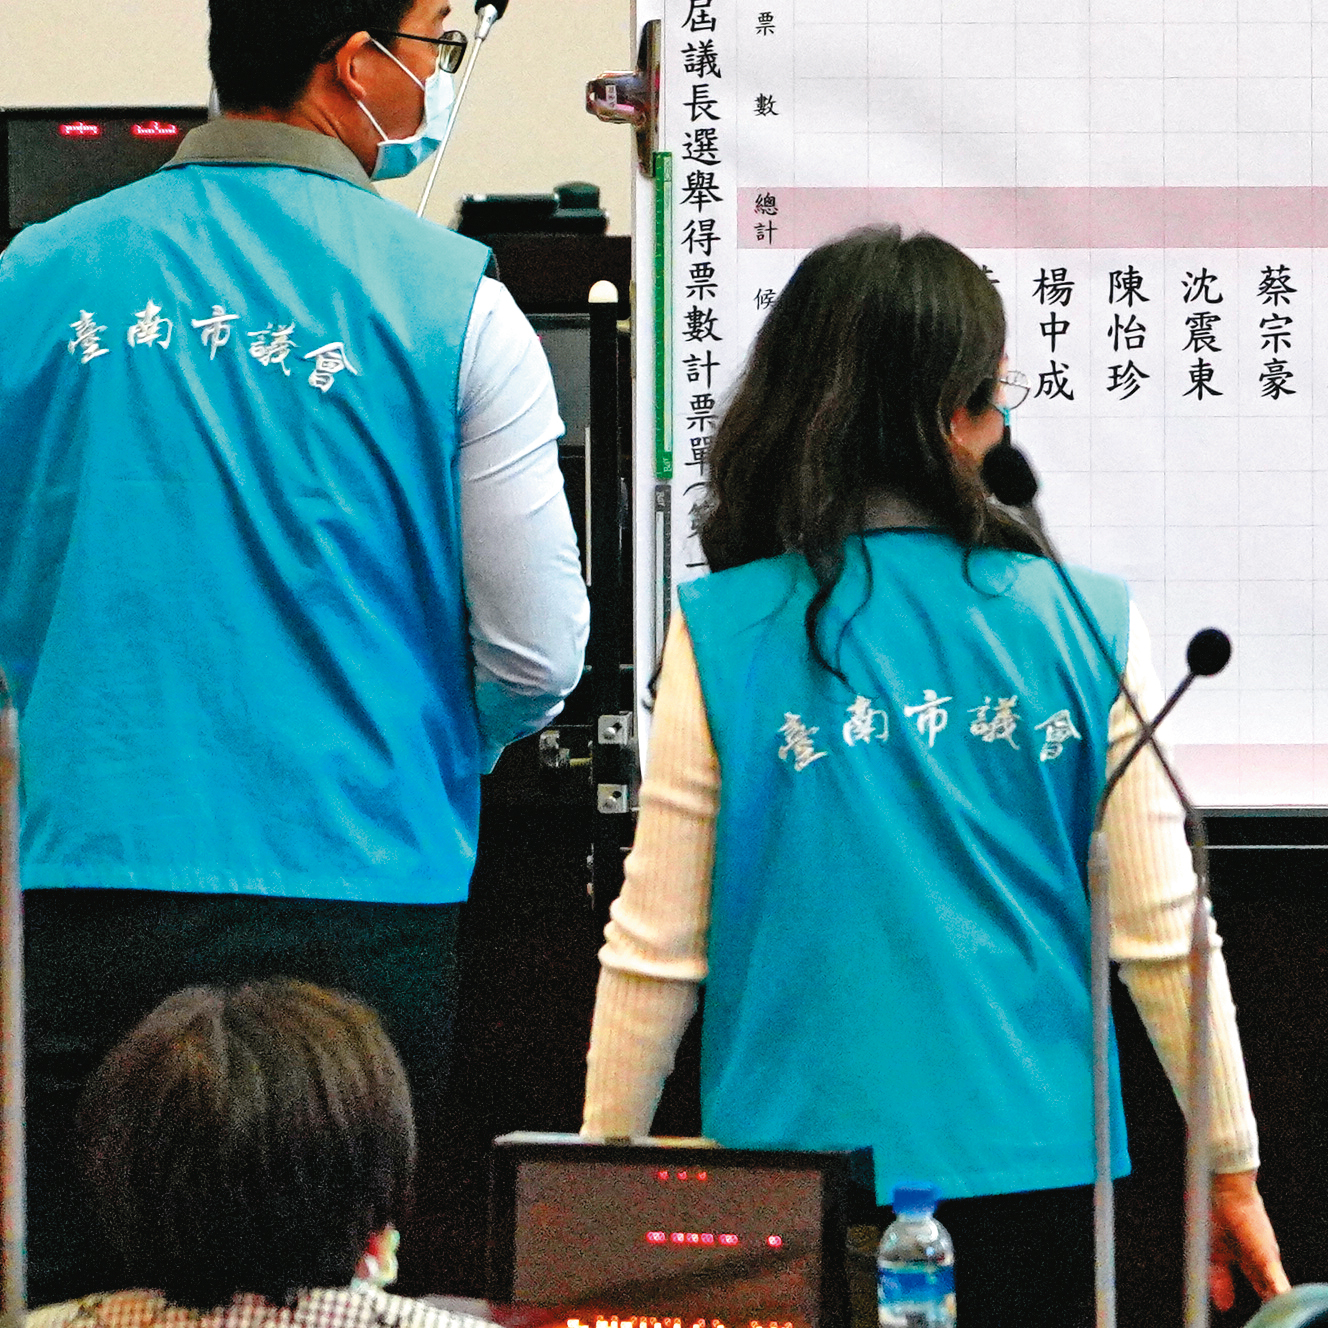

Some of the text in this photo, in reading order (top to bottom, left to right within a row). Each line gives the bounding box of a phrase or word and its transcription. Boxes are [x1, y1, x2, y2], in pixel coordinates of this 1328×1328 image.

[755, 193, 778, 240] 總計
[70, 301, 357, 391] 臺南市議會
[1032, 268, 1074, 400] 楊中成
[1108, 265, 1149, 400] 陳怡珍
[1182, 268, 1223, 400] 沈震東
[1258, 265, 1296, 399] 蔡宗豪
[780, 690, 1079, 770] 臺南市議會
